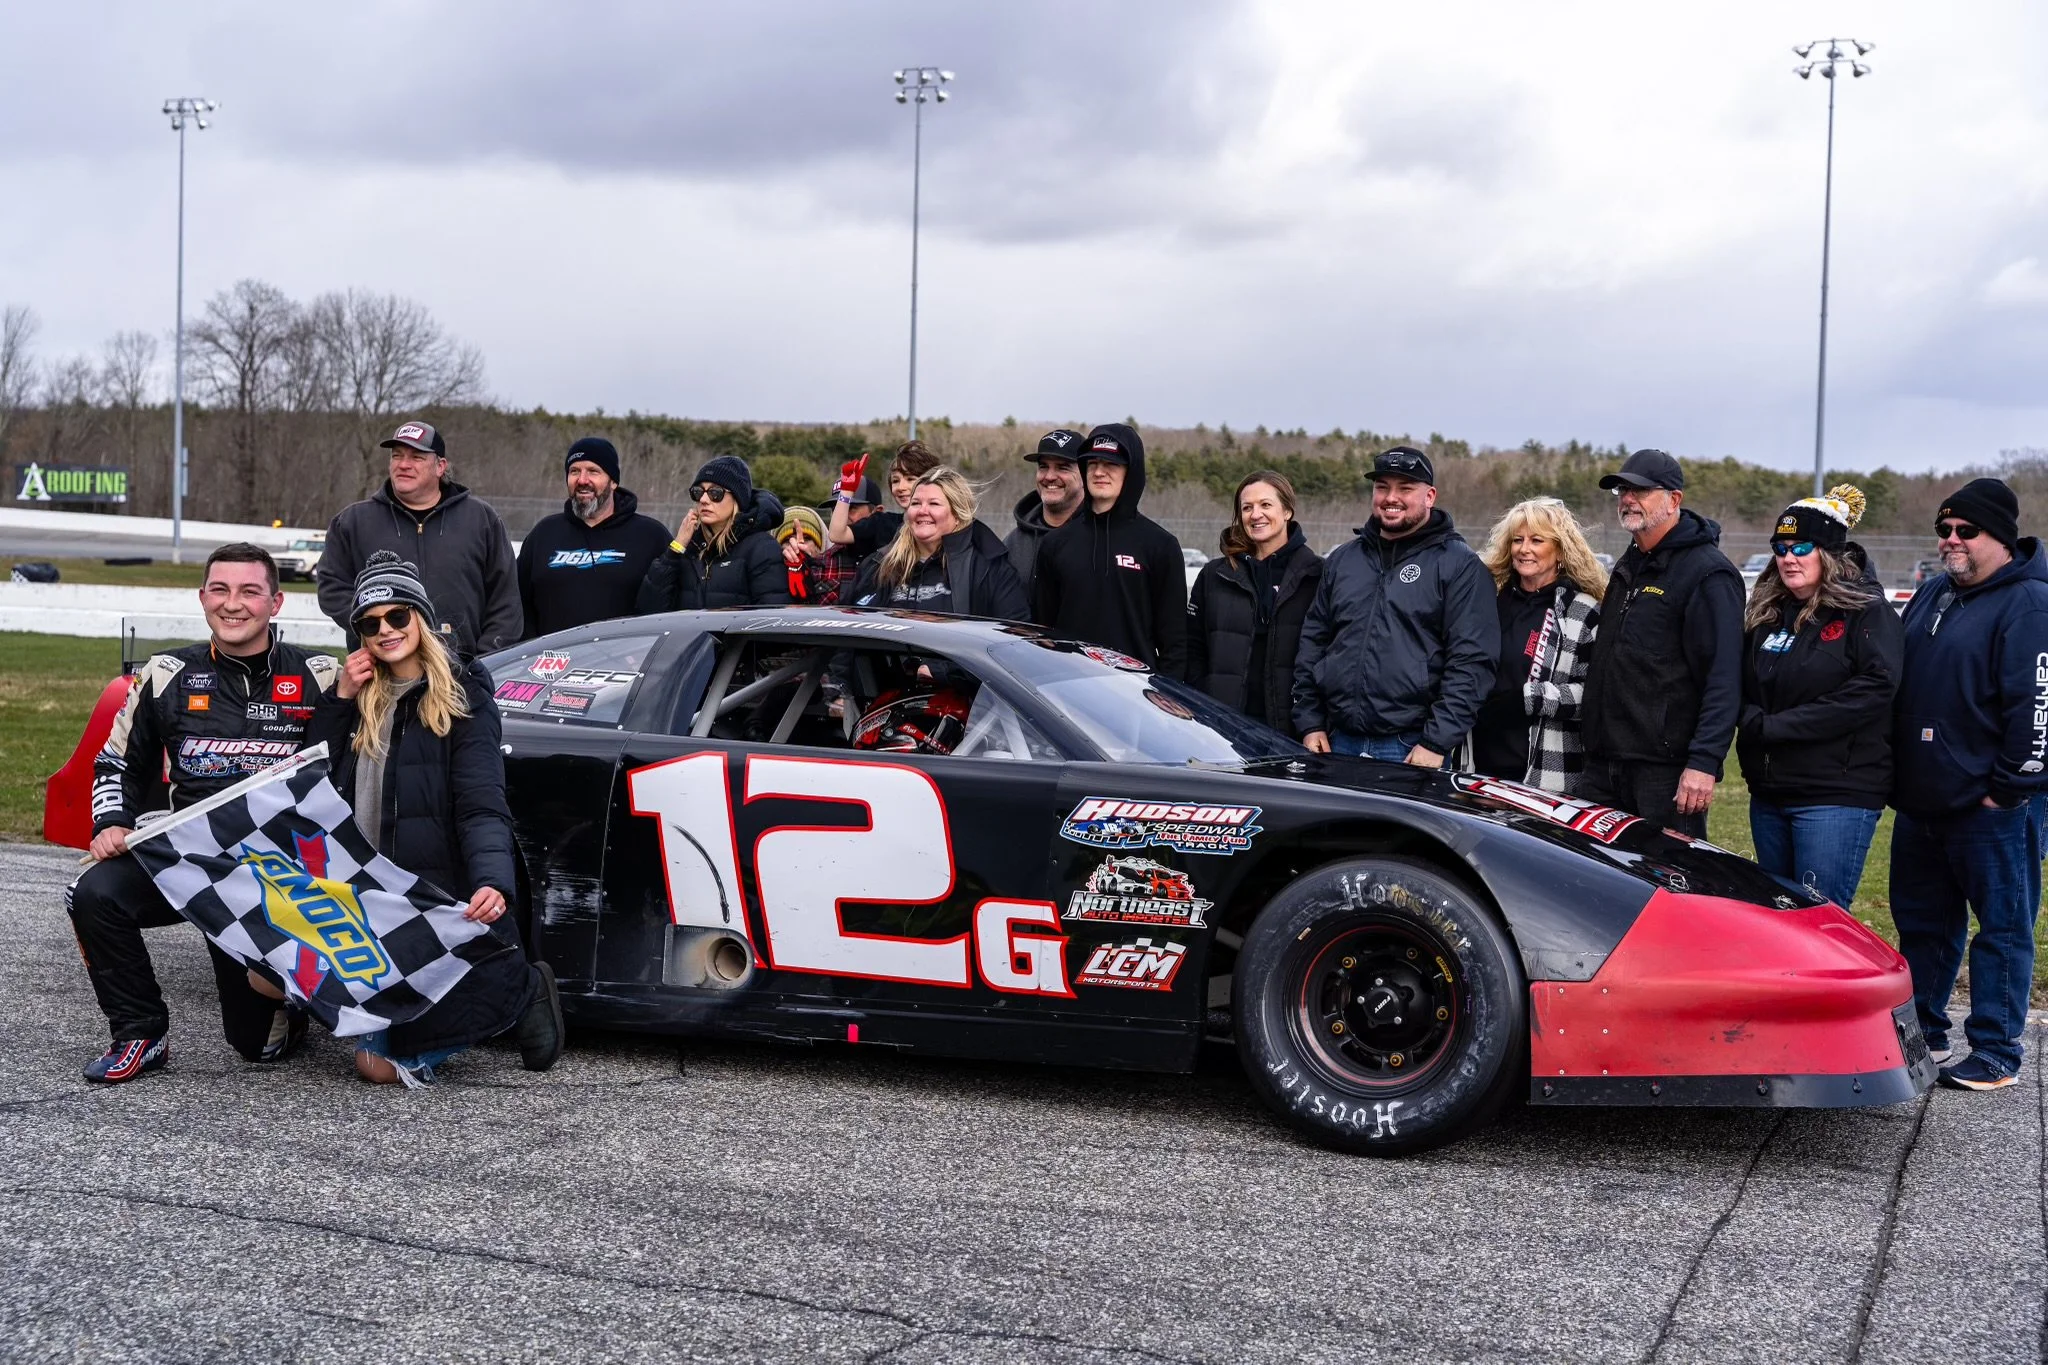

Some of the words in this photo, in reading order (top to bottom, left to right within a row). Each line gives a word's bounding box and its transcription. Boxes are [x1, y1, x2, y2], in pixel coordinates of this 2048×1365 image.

[46, 470, 127, 494] ROOFING
[180, 738, 299, 756] HUDSON
[1072, 800, 1254, 825] HUDSON
[1152, 822, 1253, 836] SPEEDWAY
[1160, 832, 1181, 841] THE
[1182, 833, 1221, 843] FAMILY
[1222, 836, 1247, 845] FUN
[1177, 841, 1229, 850] TRACK
[1066, 892, 1205, 926] Northeast
[1082, 948, 1181, 981] LCM
[1082, 976, 1160, 988] MOTORSPORTS
